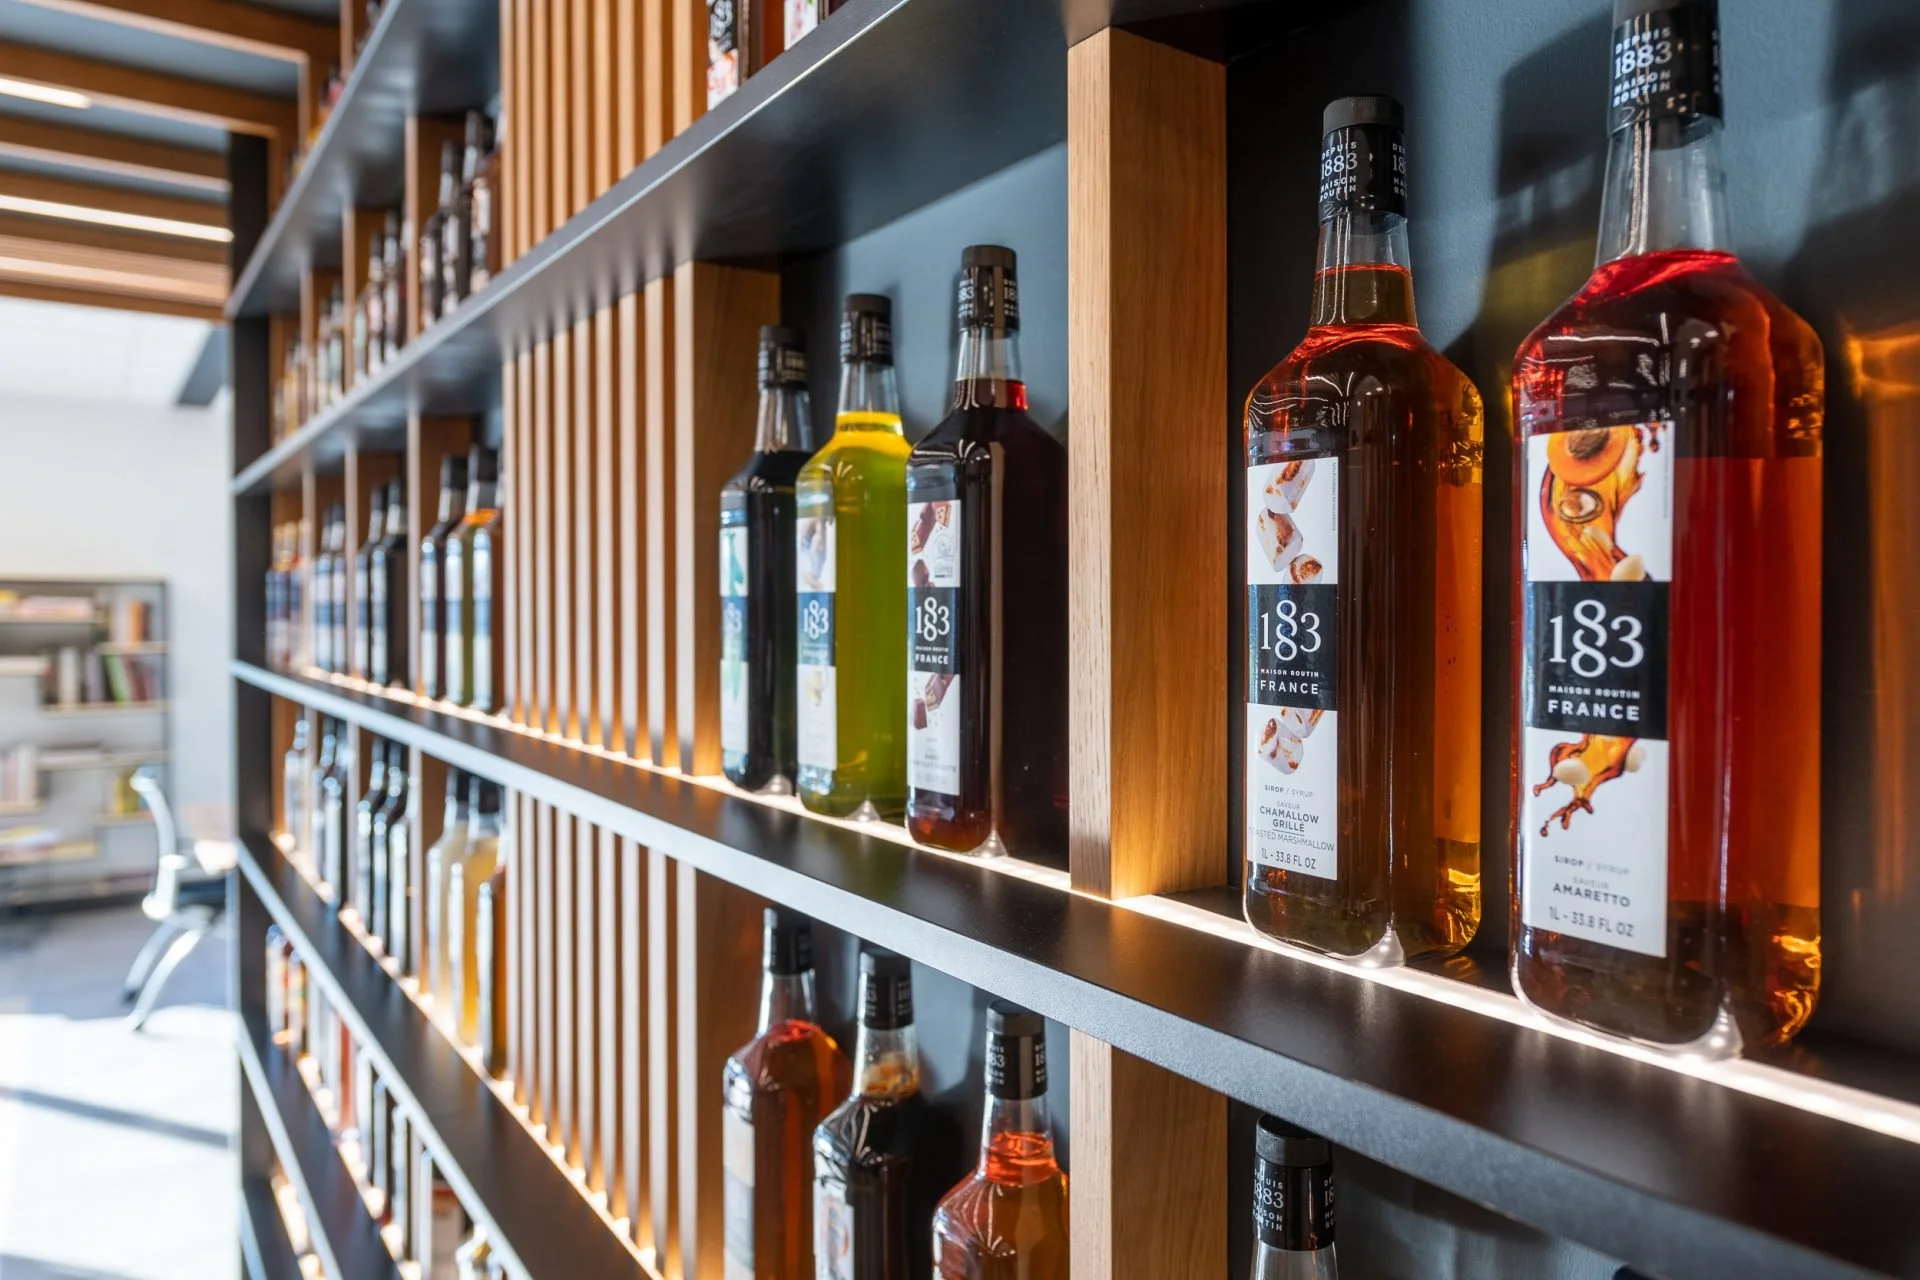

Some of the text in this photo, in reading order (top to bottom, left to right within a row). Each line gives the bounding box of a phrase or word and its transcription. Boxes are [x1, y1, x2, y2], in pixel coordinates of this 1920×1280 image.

[1615, 27, 1671, 54] DEPUIS
[1614, 41, 1673, 79] 1883
[1612, 80, 1671, 108] ROUTIN
[1614, 69, 1671, 96] MAISON
[1321, 141, 1357, 160] DEPUIS
[1320, 152, 1358, 180] 1883
[1320, 175, 1357, 194] MAISON
[803, 599, 829, 640] 1883
[915, 597, 950, 642] 1883
[1260, 600, 1322, 661] 1883
[1549, 599, 1644, 678] 1883
[914, 653, 949, 665] FRANCE
[1260, 668, 1319, 678] MAISON ROUTIN
[1260, 680, 1319, 695] FRANCE
[1548, 685, 1641, 699] MAISON ROUTIN
[1547, 700, 1640, 721] FRANCE
[1264, 784, 1284, 793] SIROP
[1291, 789, 1314, 798] SYRUP
[1259, 805, 1319, 824] CHAMALLOW
[1276, 800, 1301, 810] SAVEUR
[1277, 833, 1335, 852] MARSHMALLOW
[1261, 847, 1268, 860] 1L
[1293, 854, 1303, 867] FL
[1304, 857, 1317, 870] OZ
[1552, 882, 1631, 908] AMARETTO
[1549, 906, 1561, 921] 1L
[1599, 916, 1613, 933] FL
[1616, 921, 1635, 938] OZ
[1254, 1179, 1284, 1209] 1883
